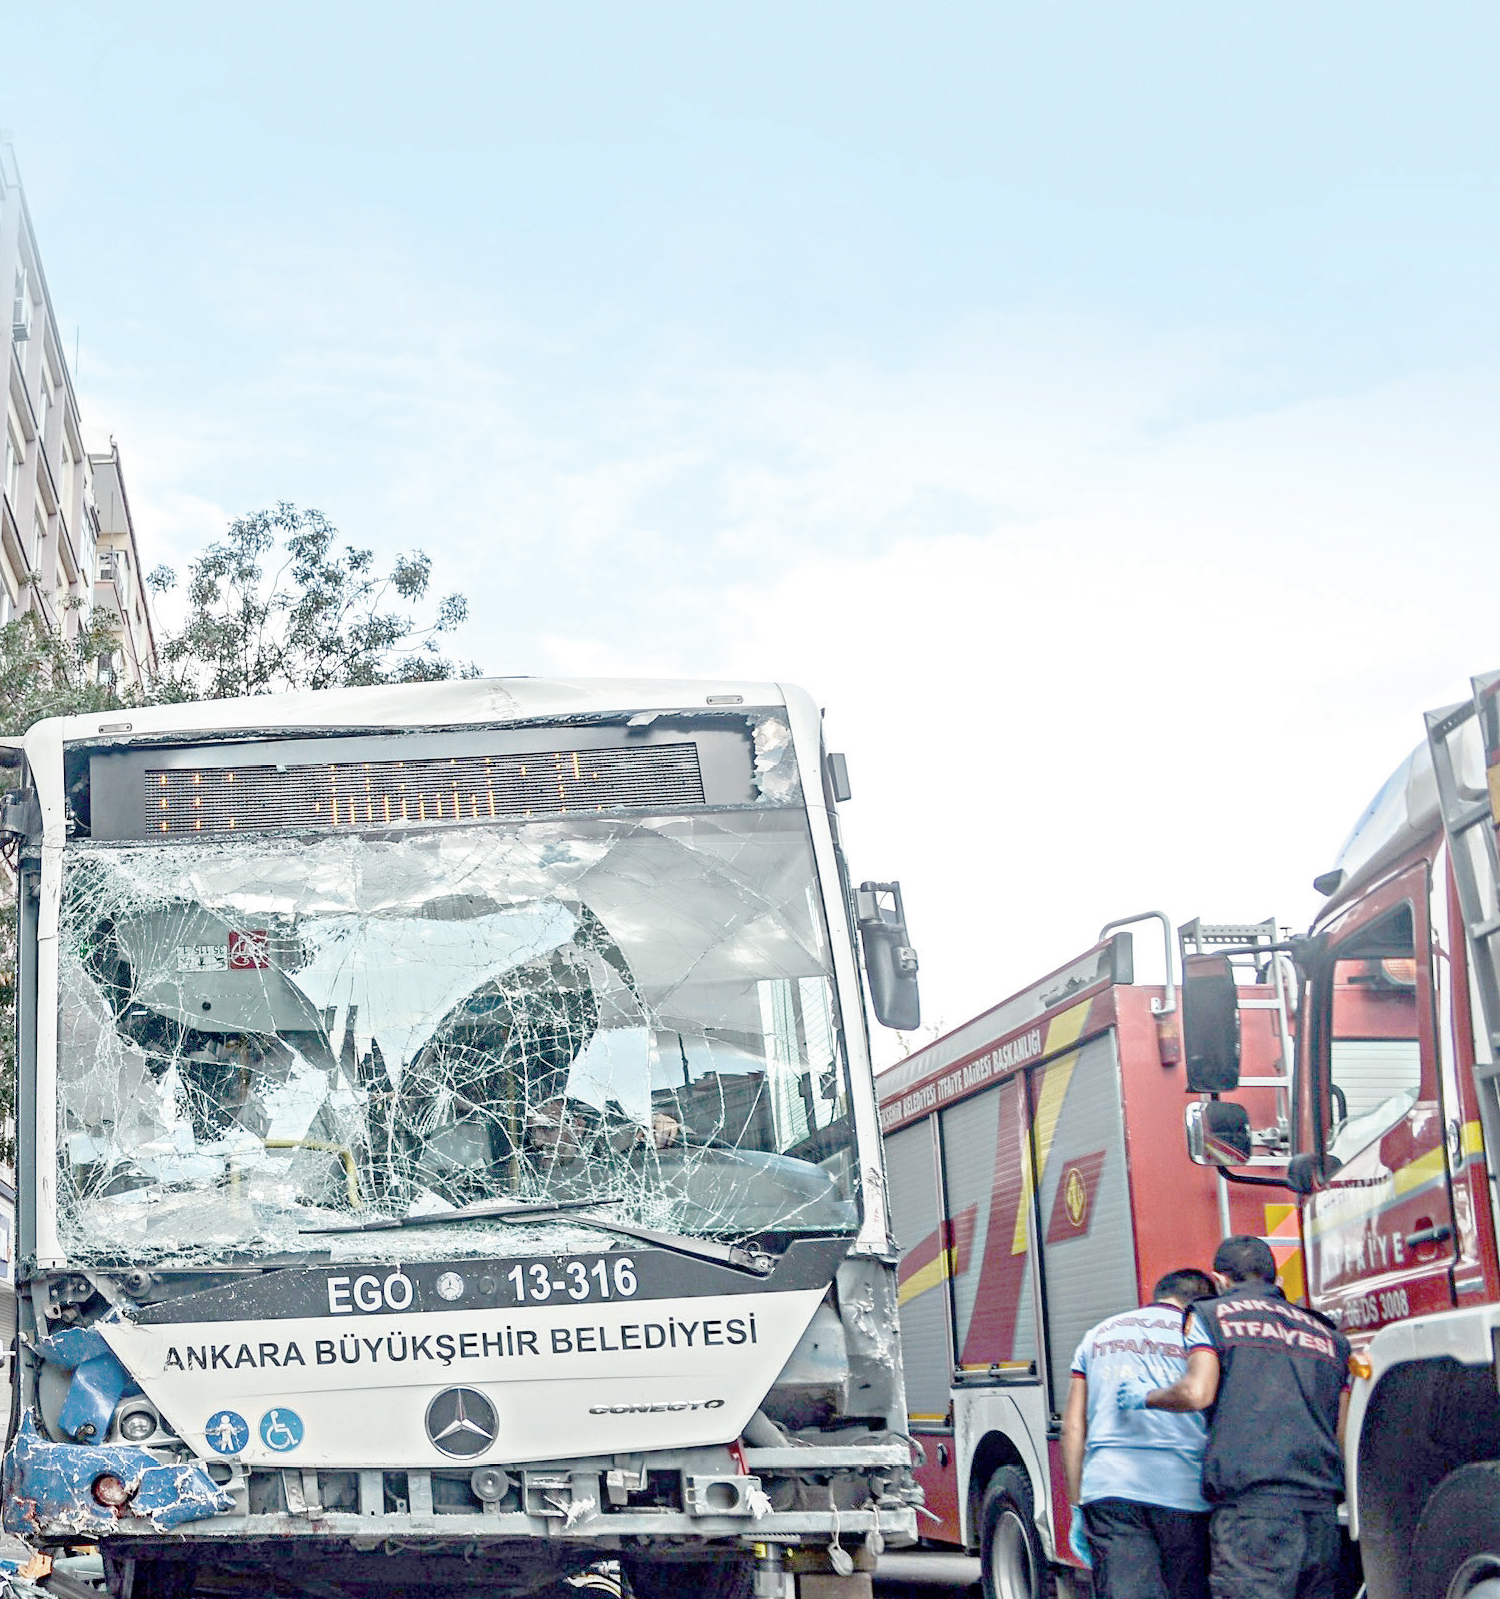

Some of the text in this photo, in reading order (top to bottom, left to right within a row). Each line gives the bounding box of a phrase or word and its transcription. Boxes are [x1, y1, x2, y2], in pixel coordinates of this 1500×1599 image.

[993, 1029, 1042, 1073] BAŞKANLIĞI
[328, 1258, 638, 1314] EGO 13-316
[1379, 1289, 1409, 1320] 3008
[1096, 1316, 1185, 1335] ANKAR
[1216, 1299, 1333, 1336] ANKARA
[164, 1312, 759, 1372] ANKARA BÜYÜKŞEHİR BELEDİYESİ
[1092, 1338, 1188, 1358] İTFAİYES
[1219, 1320, 1336, 1358] İTFAİYESİ
[588, 1399, 725, 1416] CONECTO
